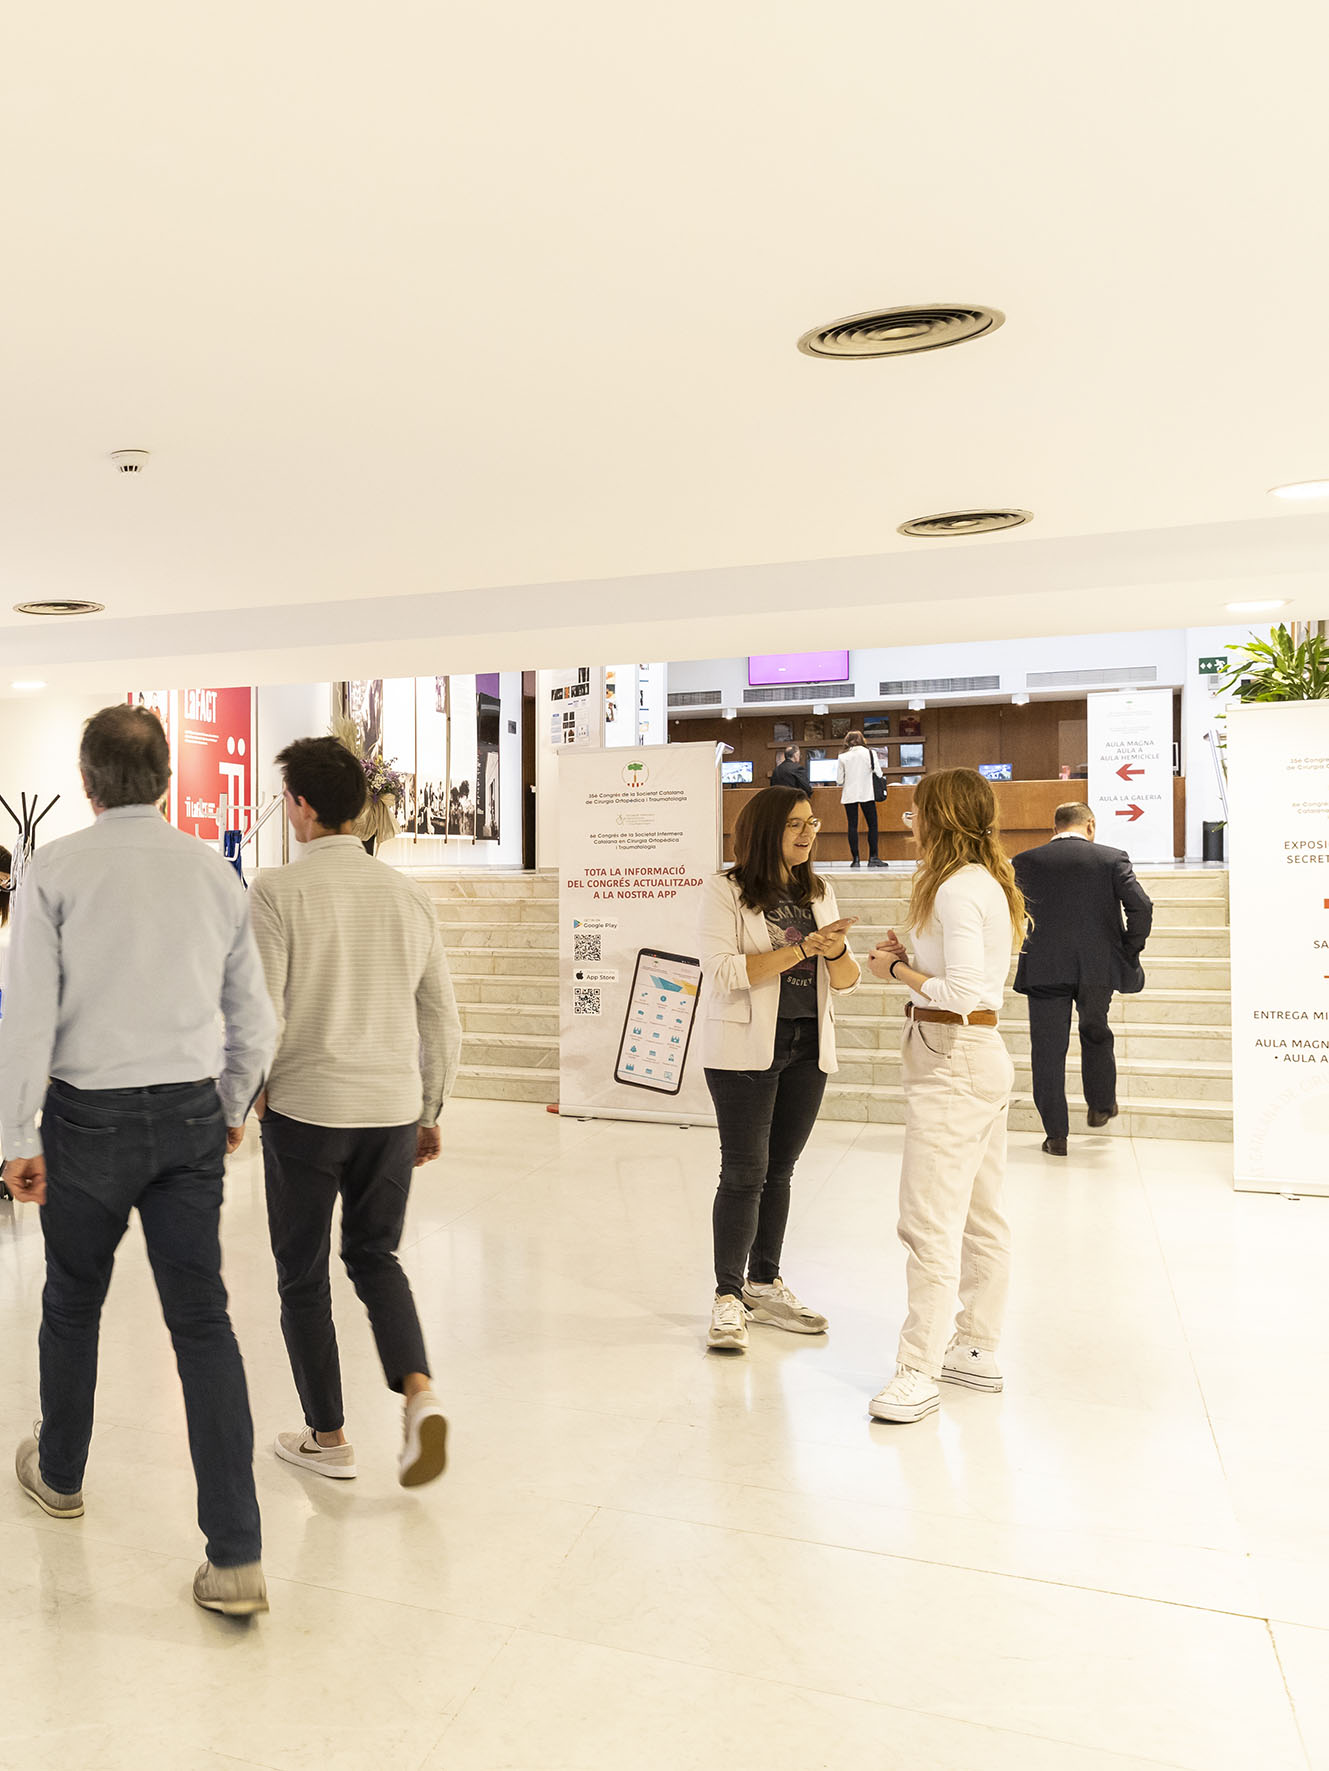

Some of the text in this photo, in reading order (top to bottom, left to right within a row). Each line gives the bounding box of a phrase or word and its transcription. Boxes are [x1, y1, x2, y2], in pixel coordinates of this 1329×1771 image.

[1127, 739, 1155, 747] MAGNA
[1121, 753, 1160, 761] HEMICICLE
[1099, 793, 1162, 802] AULA LA GALERIA
[1284, 840, 1329, 850] EXPOSI
[1286, 854, 1329, 864] SECRET
[584, 864, 686, 877] TOTA LA INFORMACIÓ
[567, 876, 704, 889] DEL CONGRÉS ACTUALITZADA
[593, 890, 678, 900] A LA NOSTRA APP
[1313, 940, 1329, 950] SA
[1253, 1010, 1329, 1020] ENTREGA MI
[1255, 1039, 1329, 1049] AULA MAGN
[1283, 1054, 1316, 1063] AULA
